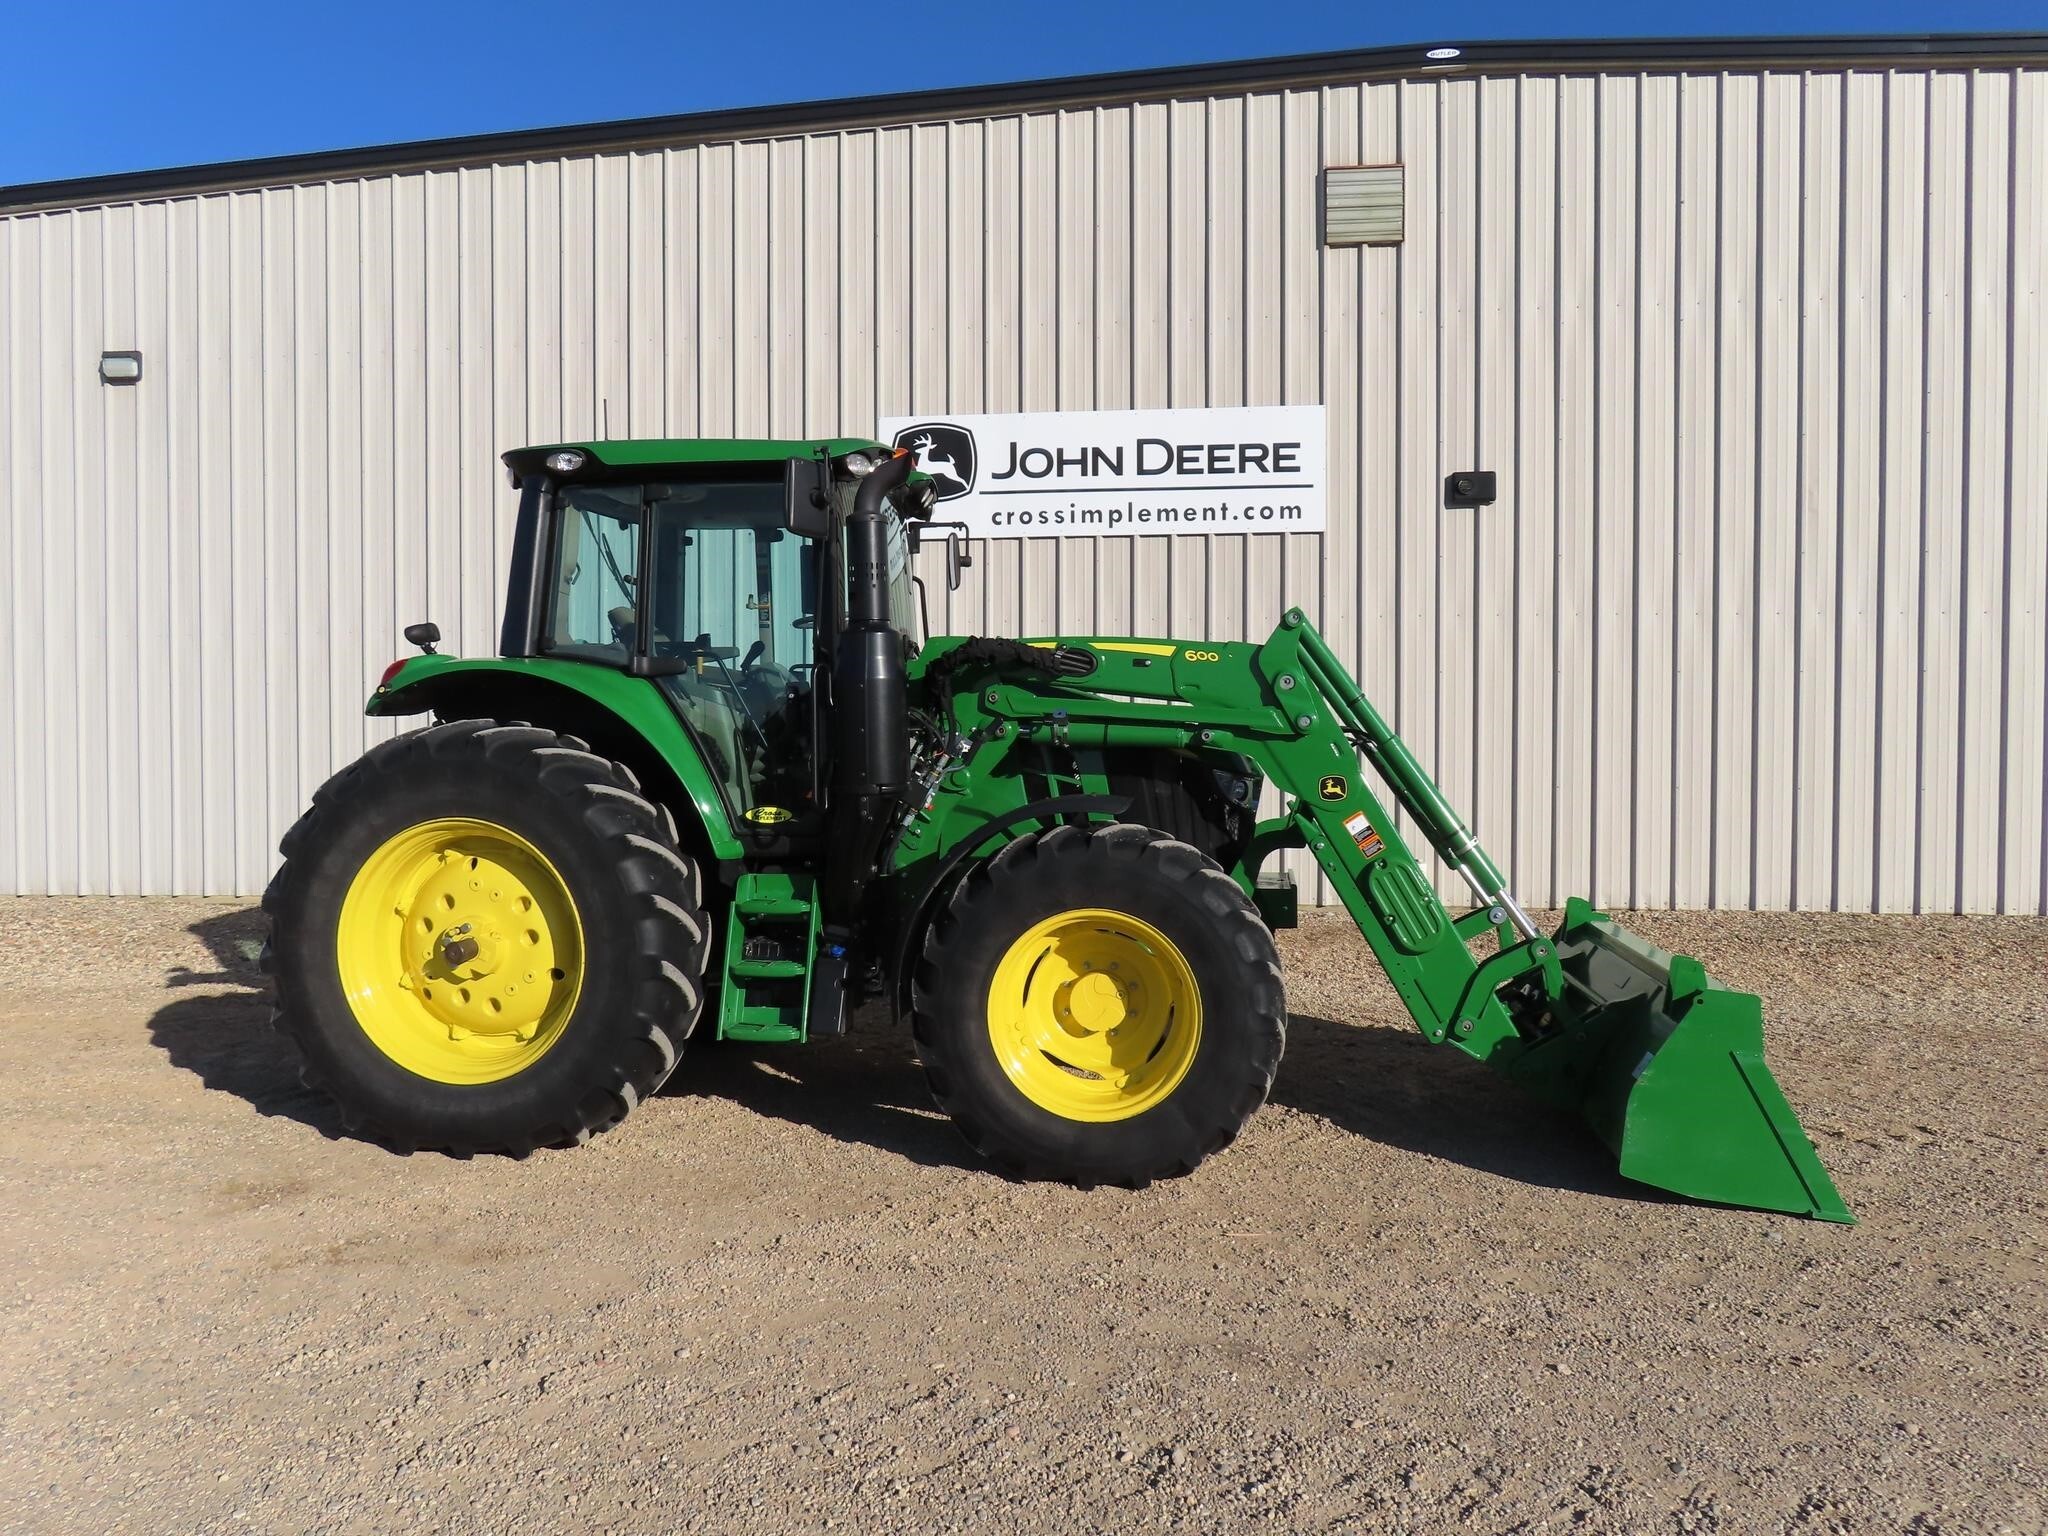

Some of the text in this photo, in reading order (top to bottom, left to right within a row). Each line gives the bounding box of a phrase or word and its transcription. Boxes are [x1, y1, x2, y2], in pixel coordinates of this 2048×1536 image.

[991, 438, 1301, 480] JOHN DEERE
[991, 502, 1302, 529] crossimplement.com
[1184, 650, 1219, 662] 600
